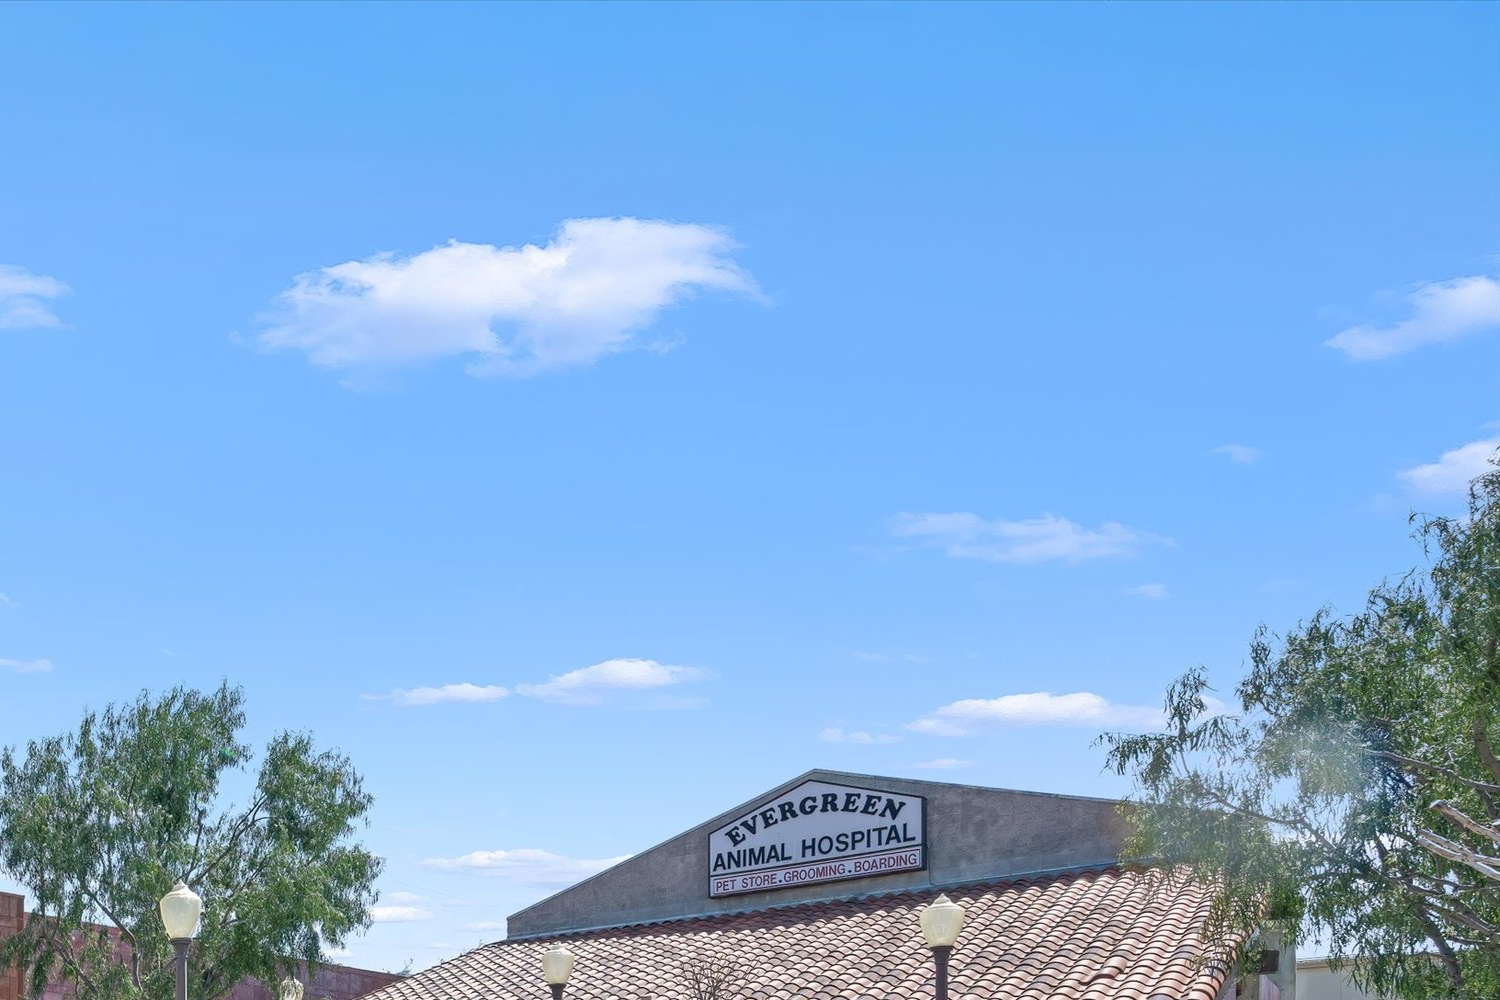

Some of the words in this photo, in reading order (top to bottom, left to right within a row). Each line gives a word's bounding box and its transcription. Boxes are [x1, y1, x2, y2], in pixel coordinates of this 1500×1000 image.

[724, 792, 906, 847] EVERGREEN
[712, 842, 792, 872] ANIMAL
[801, 823, 916, 858] HOSPITAL
[715, 878, 737, 893] PET
[741, 873, 777, 889] STORE
[783, 865, 846, 883] GROOMING
[854, 853, 917, 873] BOARDING
